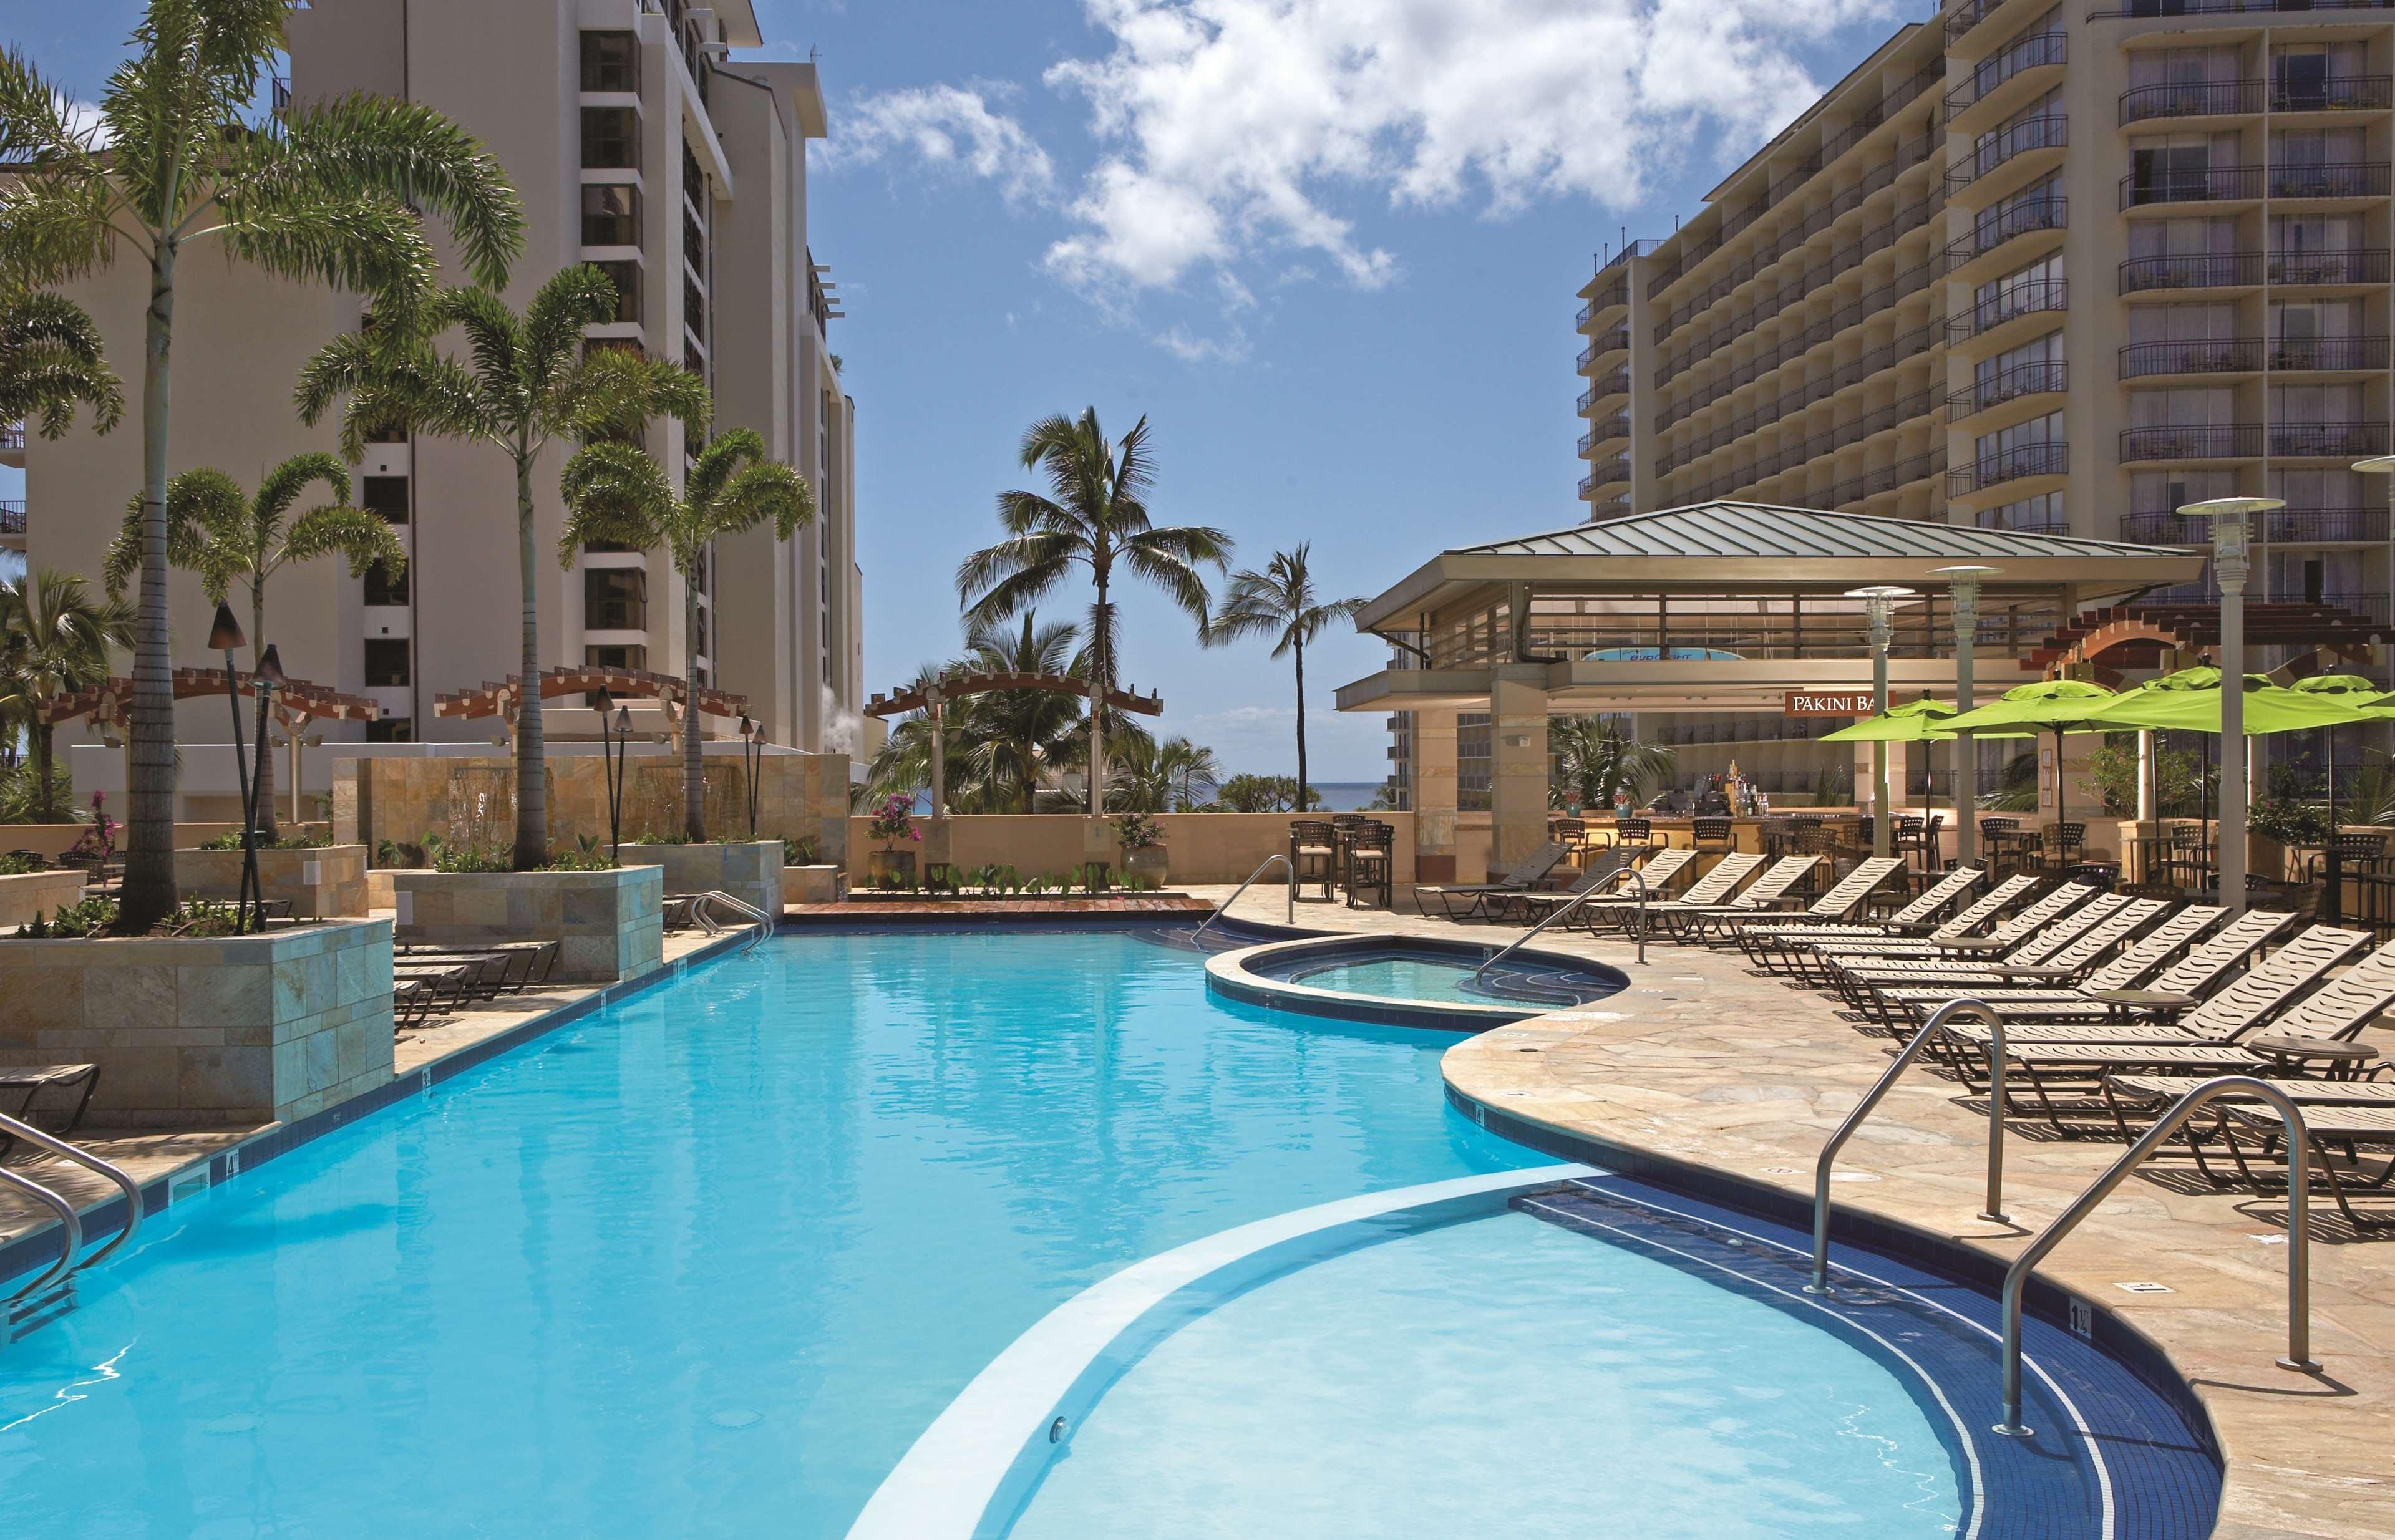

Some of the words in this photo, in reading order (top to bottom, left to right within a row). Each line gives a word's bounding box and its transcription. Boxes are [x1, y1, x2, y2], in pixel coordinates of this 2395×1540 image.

[1793, 696, 1852, 711] PĀKINI
[1856, 696, 1875, 711] BA
[228, 1155, 235, 1174] 4
